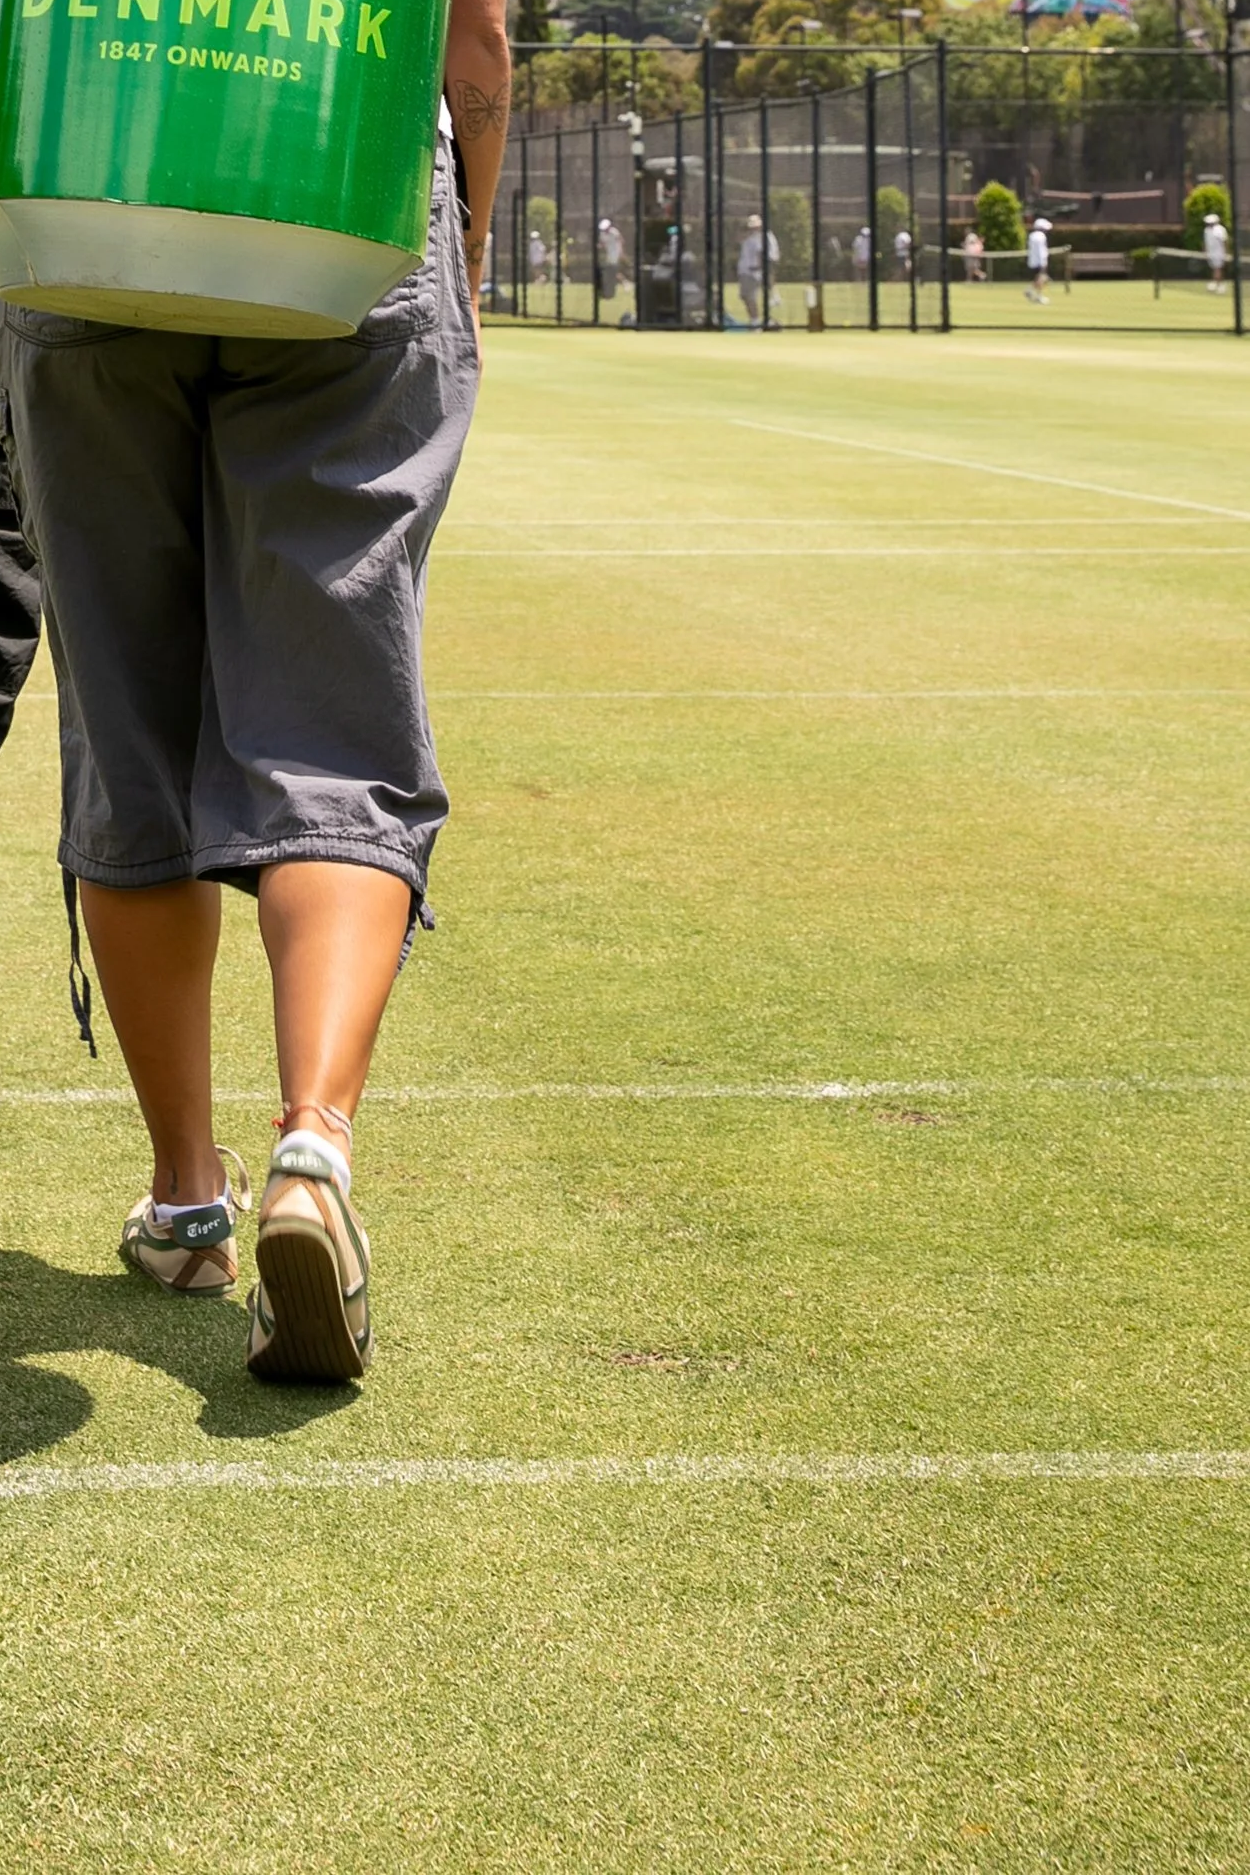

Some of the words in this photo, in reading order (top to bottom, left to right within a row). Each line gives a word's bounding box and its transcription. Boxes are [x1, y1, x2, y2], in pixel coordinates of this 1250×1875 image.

[99, 40, 158, 62] 1847
[167, 45, 303, 81] ONWARDS
[187, 1218, 221, 1238] Tiger
